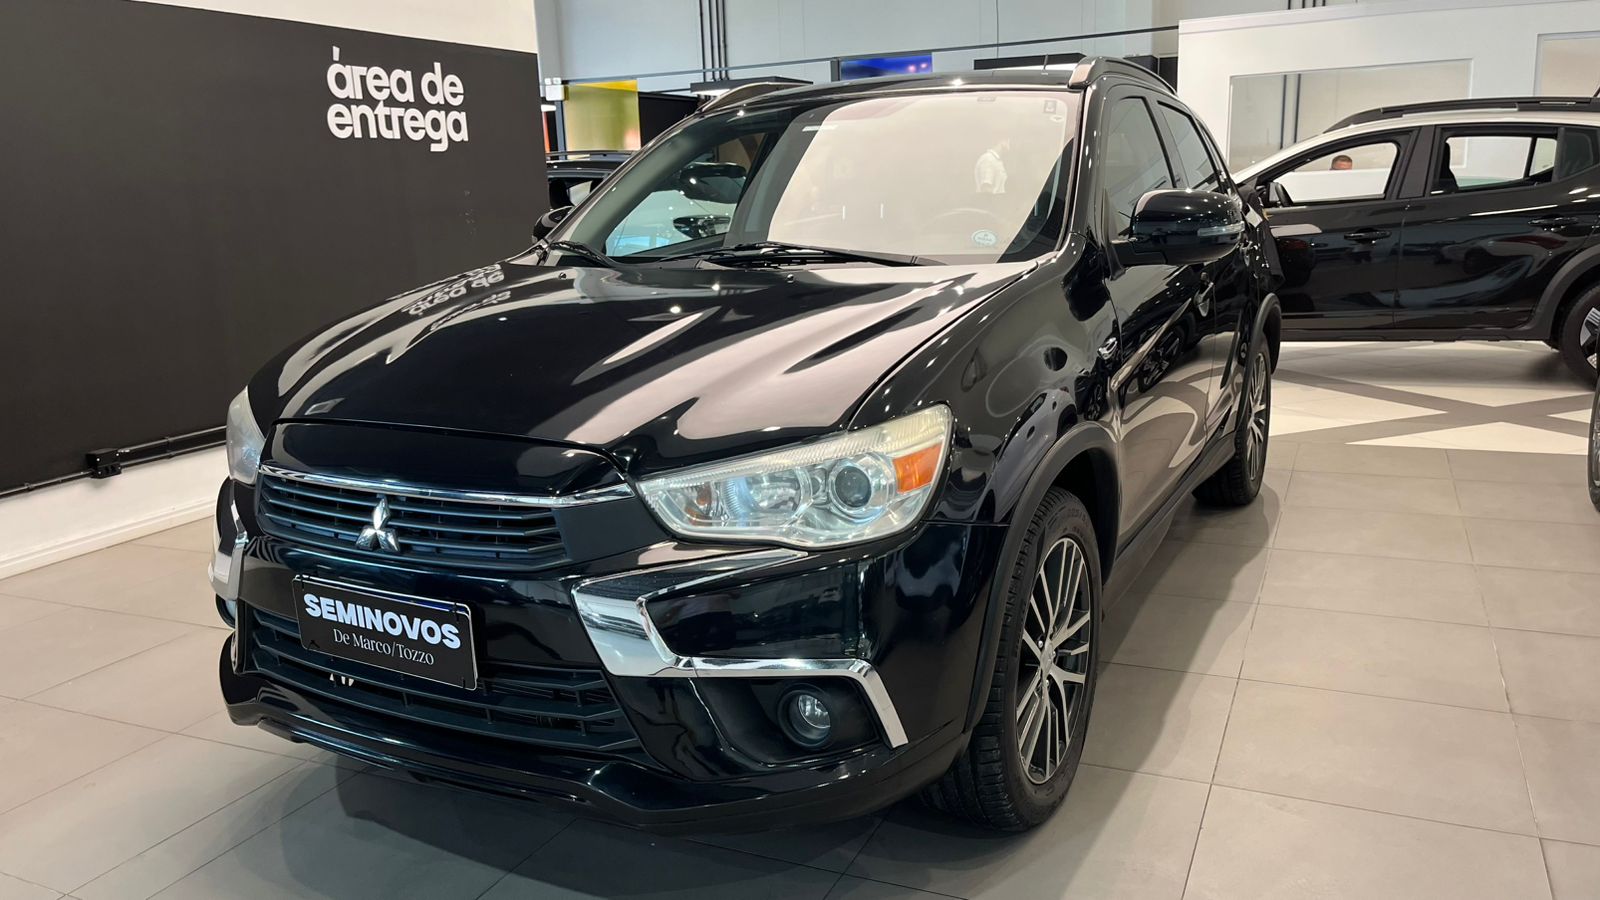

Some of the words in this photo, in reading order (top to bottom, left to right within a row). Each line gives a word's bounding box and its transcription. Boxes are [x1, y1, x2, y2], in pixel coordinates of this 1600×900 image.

[327, 45, 415, 102] área
[421, 62, 464, 106] de
[327, 100, 469, 152] entrega
[303, 593, 461, 649] SEMINOVOS
[333, 628, 350, 645] De
[352, 633, 435, 666] Marco/Tozzo
